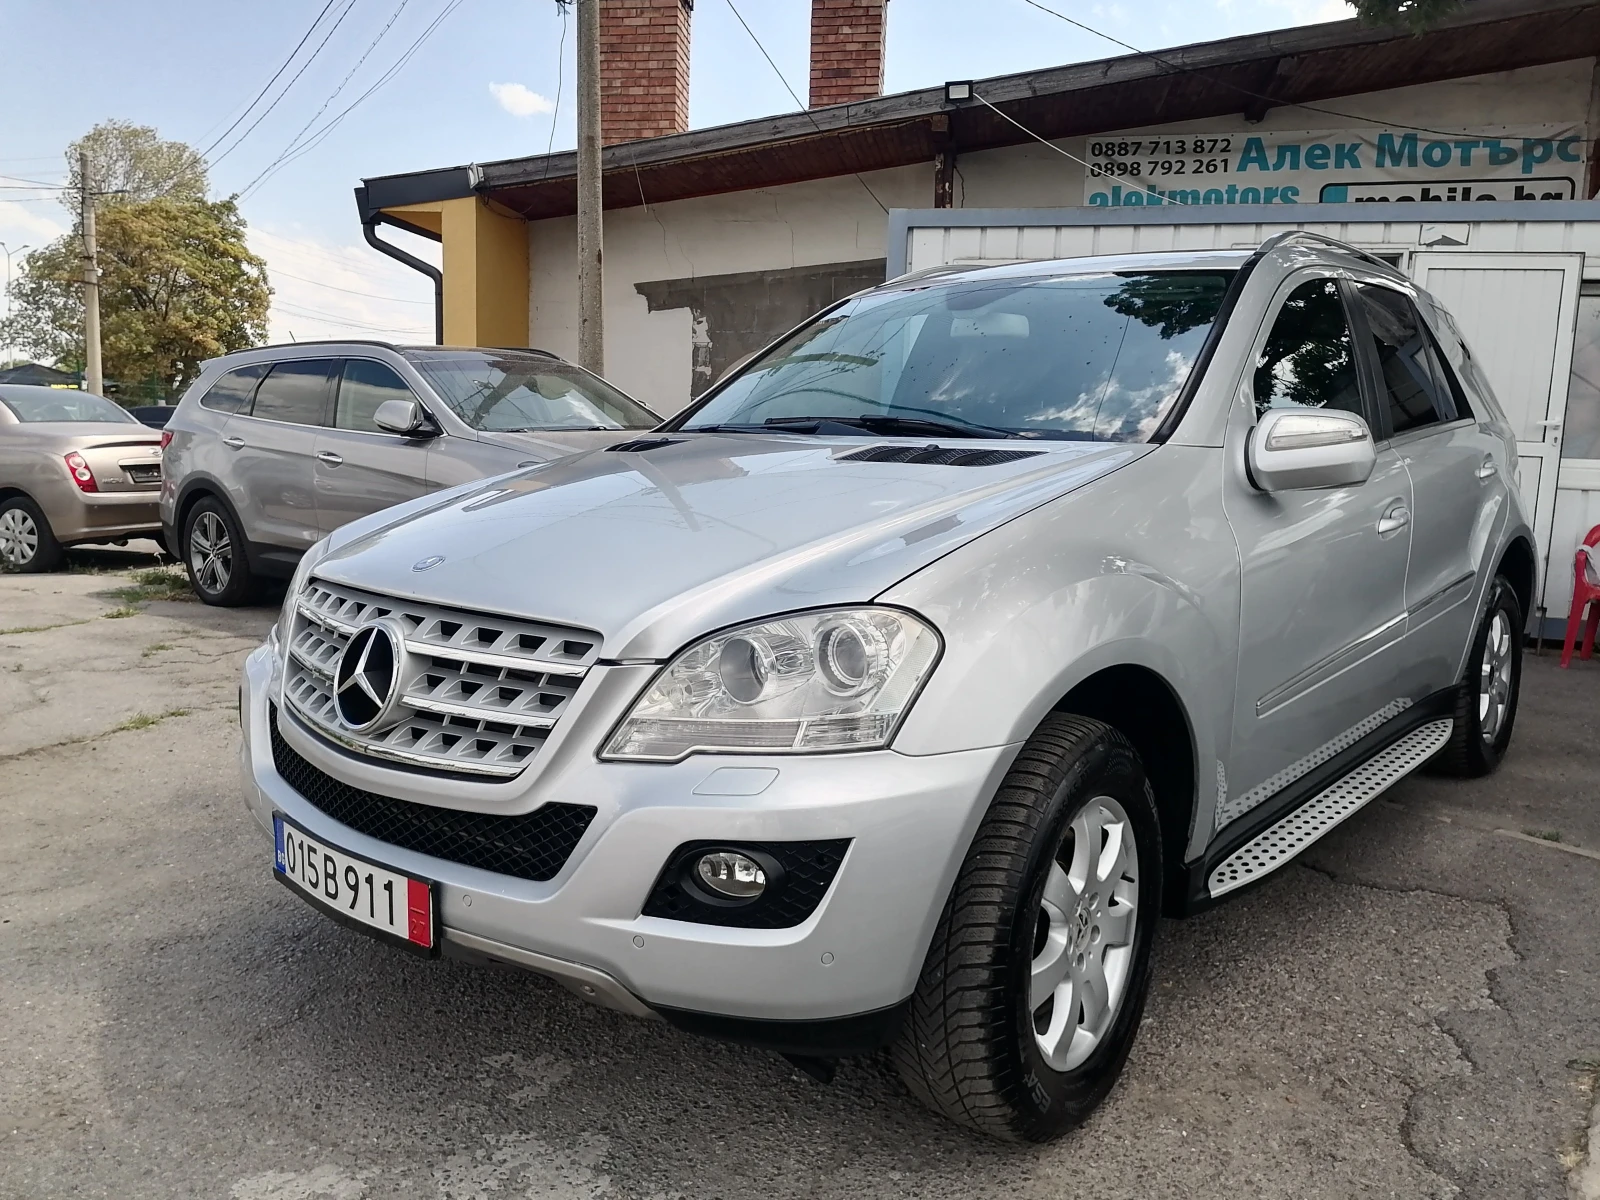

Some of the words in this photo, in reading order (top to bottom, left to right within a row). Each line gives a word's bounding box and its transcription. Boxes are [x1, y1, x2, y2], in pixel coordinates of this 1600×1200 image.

[1091, 141, 1143, 157] 0887
[1148, 140, 1187, 156] 713
[1192, 138, 1232, 154] 872
[1236, 136, 1363, 172] Алек
[1375, 133, 1582, 174] Мотърс
[1090, 161, 1142, 178] 0898
[1148, 159, 1186, 176] 792
[1192, 158, 1230, 174] 261
[286, 831, 395, 926] 015B911
